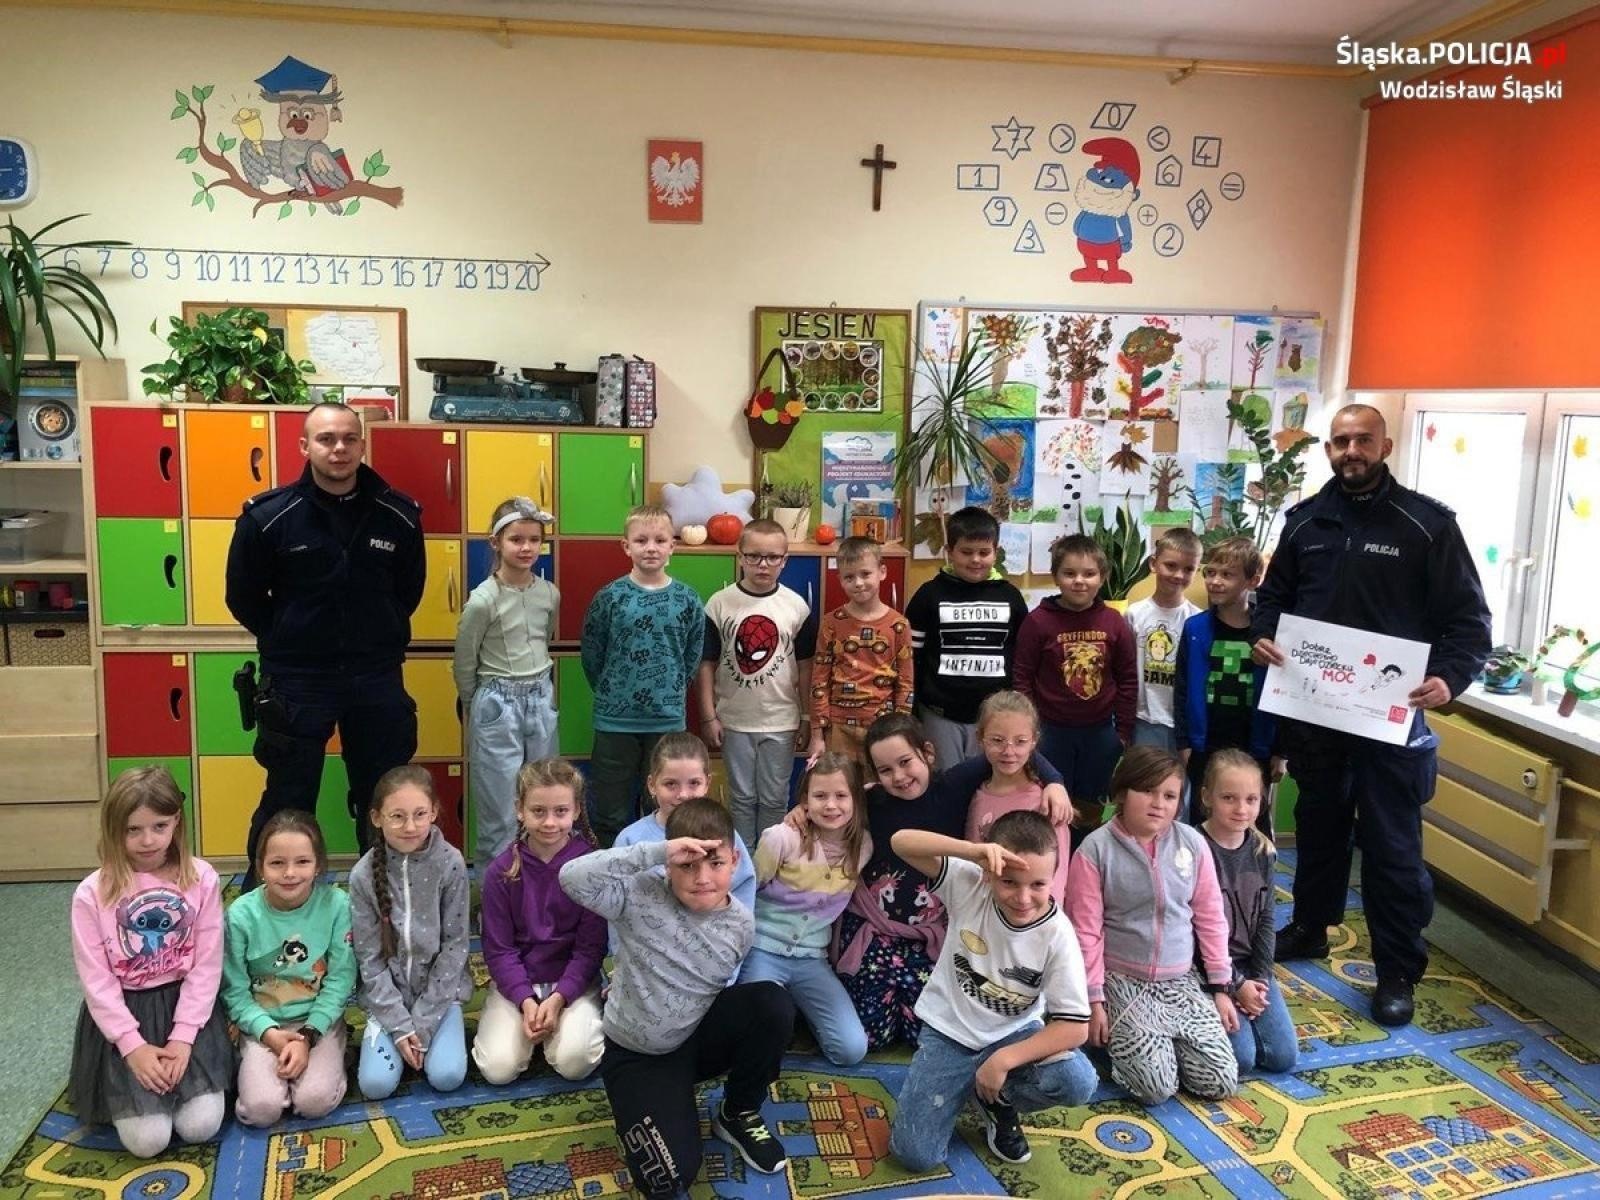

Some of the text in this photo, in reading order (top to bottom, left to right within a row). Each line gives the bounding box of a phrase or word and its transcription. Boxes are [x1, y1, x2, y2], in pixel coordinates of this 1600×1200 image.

[1006, 128, 1021, 151] 7
[1196, 139, 1212, 166] 4
[973, 167, 984, 188] 1
[1044, 165, 1060, 189] 5
[1161, 163, 1175, 185] 6
[994, 199, 1007, 223] 9
[1192, 198, 1205, 223] 8
[1022, 227, 1036, 250] 3
[1161, 225, 1176, 251] 2
[63, 248, 82, 276] 6
[96, 249, 112, 277] 7
[131, 251, 148, 280] 8
[165, 251, 181, 281] 9
[194, 253, 221, 282] 10
[228, 255, 252, 282] 11
[261, 255, 285, 284] 12
[294, 257, 321, 285] 13
[326, 258, 350, 285] 14
[358, 259, 384, 286] 15
[391, 259, 416, 287] 16
[422, 260, 445, 288] 17
[454, 262, 478, 289] 18
[484, 263, 509, 290] 19
[514, 263, 540, 292] 20
[1363, 543, 1400, 557] POLICJA
[952, 607, 999, 621] BEYOND
[1056, 630, 1107, 643] GRYFFINDOR
[945, 658, 1001, 672] INFINITY
[1322, 670, 1356, 684] MOC
